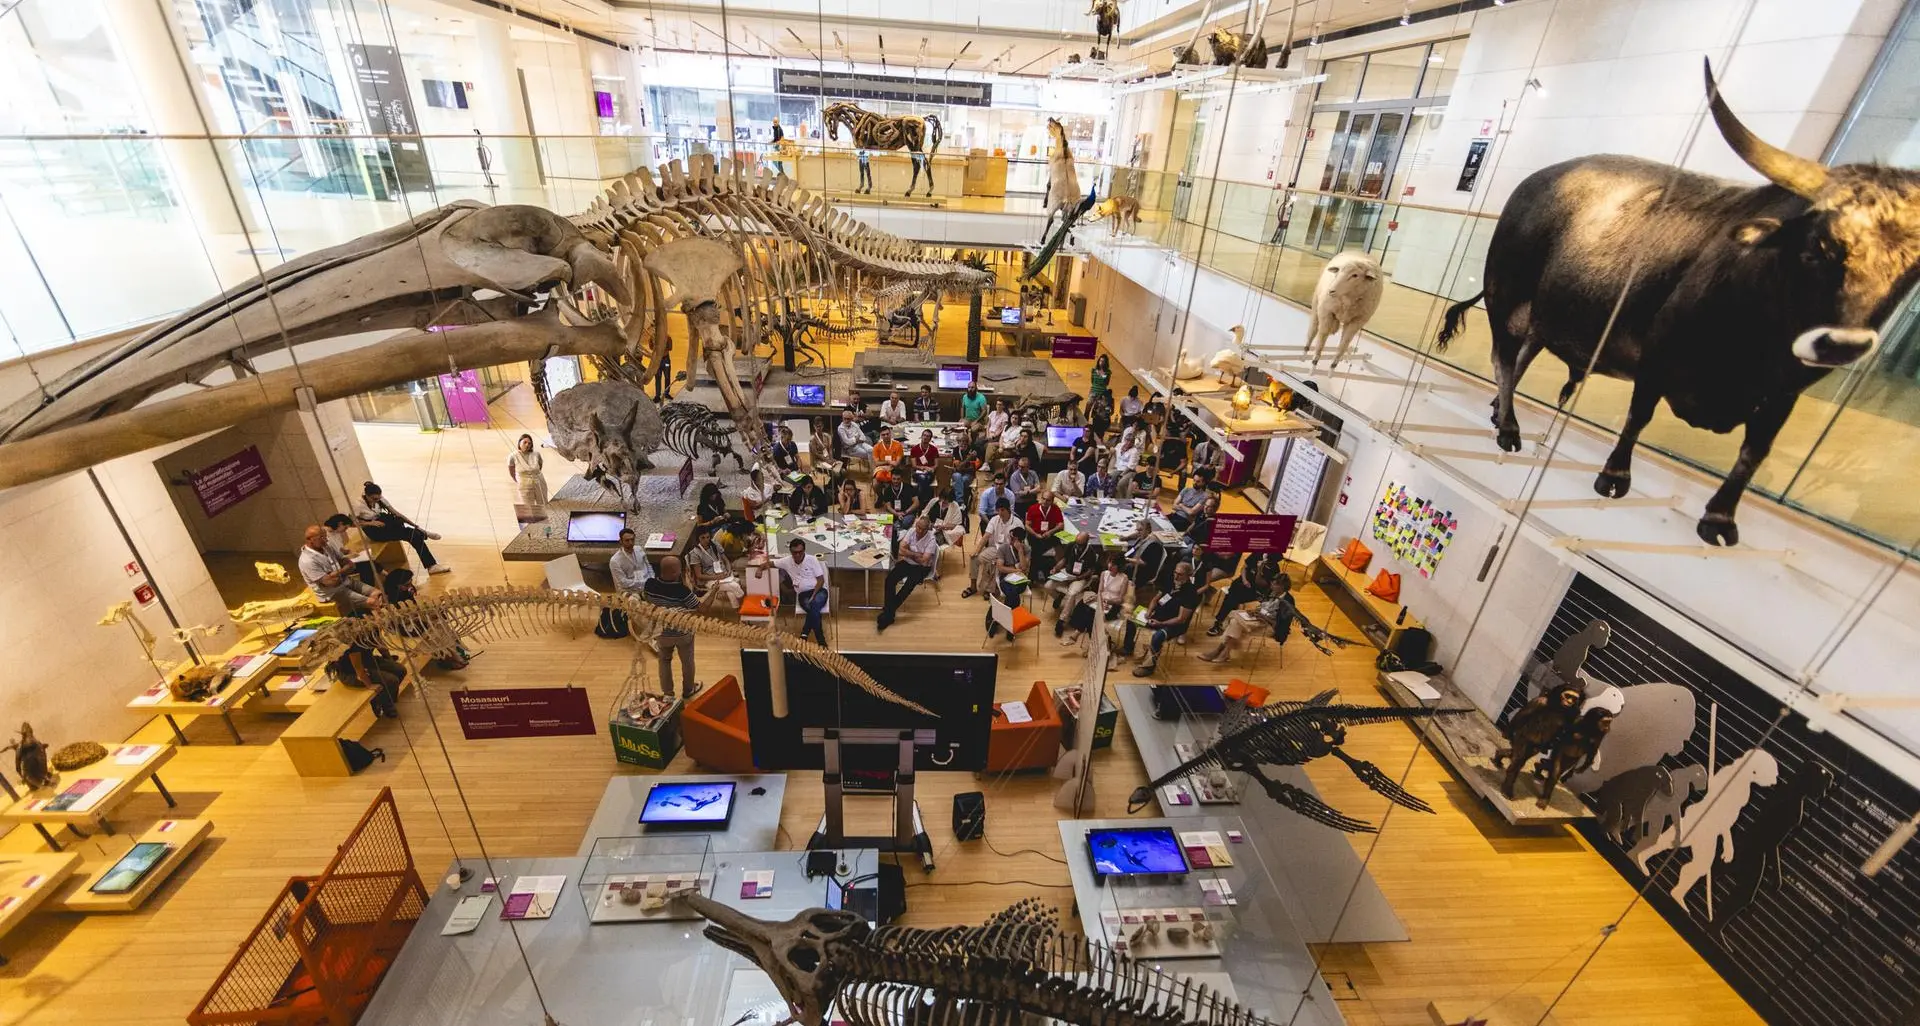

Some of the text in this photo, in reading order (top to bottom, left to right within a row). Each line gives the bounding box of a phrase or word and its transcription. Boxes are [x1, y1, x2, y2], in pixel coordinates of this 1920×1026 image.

[460, 696, 510, 704] Mosasauri
[1096, 727, 1112, 736] Se
[620, 736, 661, 759] MuSe
